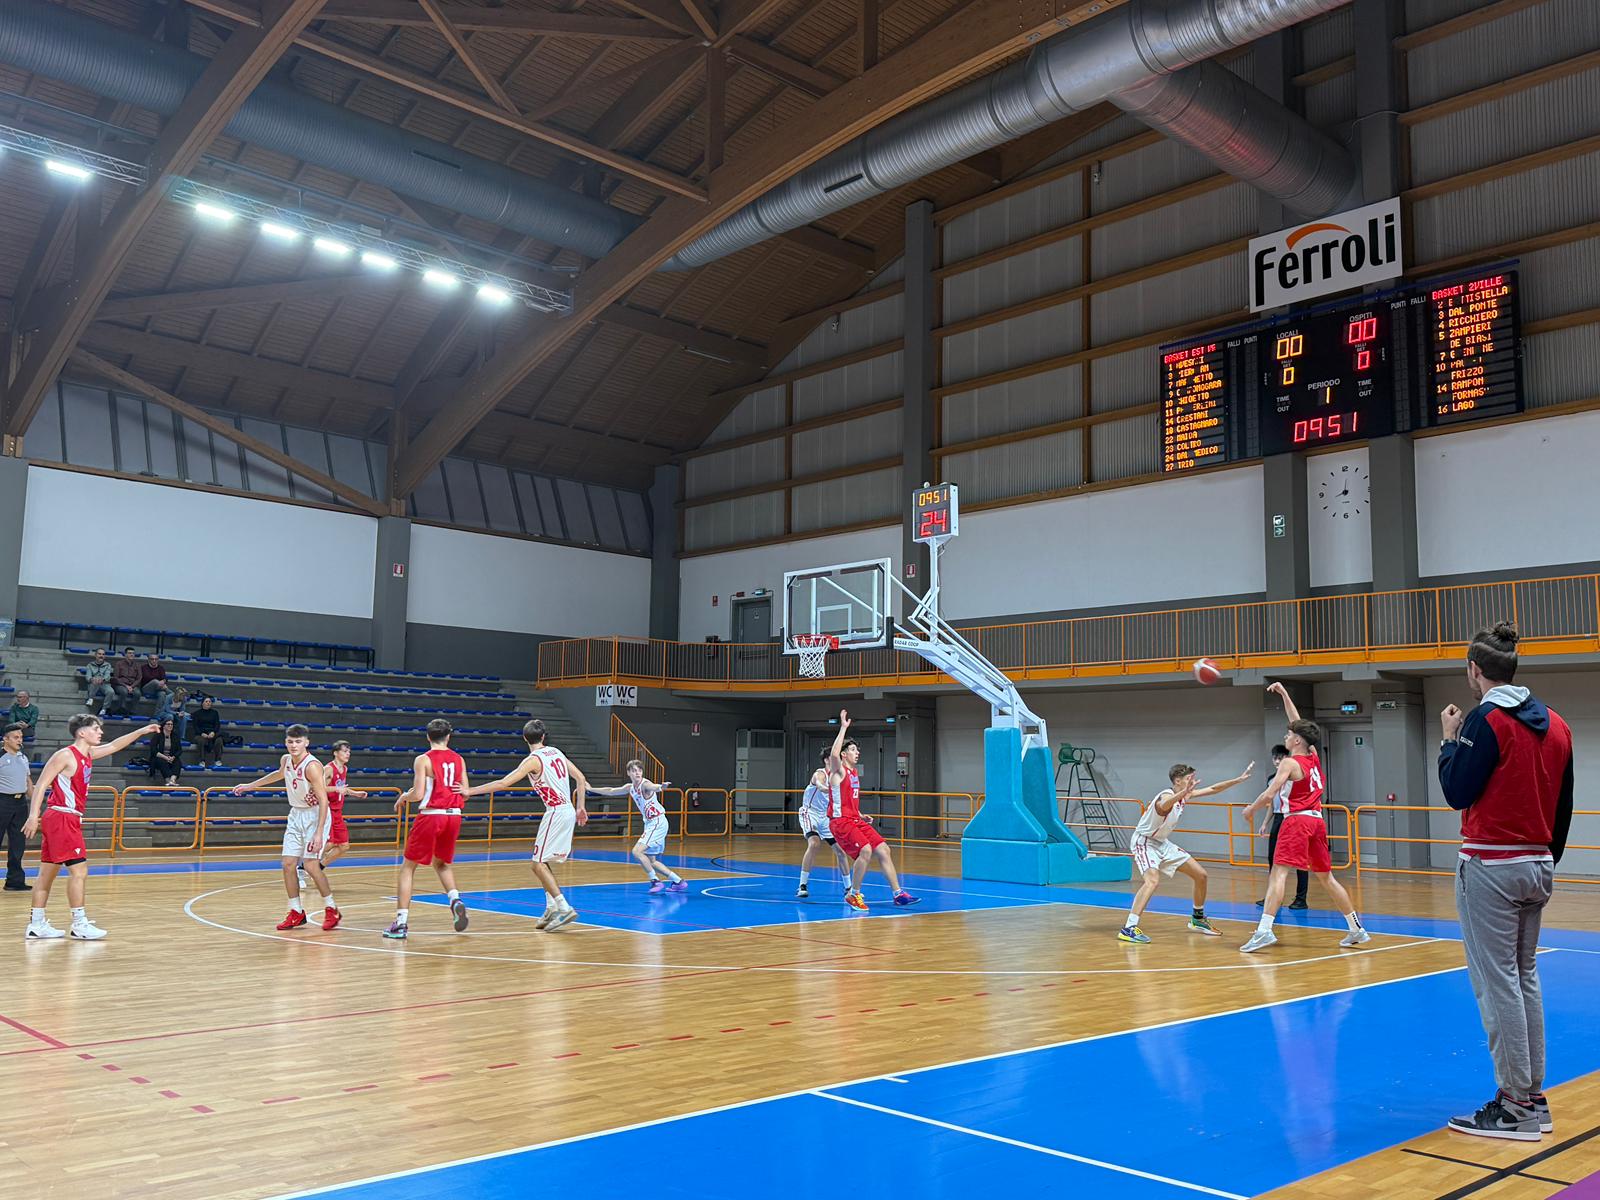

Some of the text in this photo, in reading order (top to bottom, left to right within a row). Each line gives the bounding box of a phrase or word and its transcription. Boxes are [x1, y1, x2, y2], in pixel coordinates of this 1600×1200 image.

[1255, 213, 1396, 307] Ferroli
[1432, 276, 1502, 300] BASKET 2VILLE
[1390, 300, 1406, 310] PUNTI
[1410, 296, 1426, 304] FALLI
[1449, 307, 1464, 317] DAL
[1470, 299, 1497, 313] PONTE
[1350, 312, 1372, 322] OSPITI
[1439, 310, 1498, 329] 4 RICCHIERO
[1276, 330, 1298, 340] LOCALI
[1439, 322, 1491, 340] 5 ZAMPIERI
[1450, 339, 1460, 349] DE
[1164, 351, 1188, 363] BASKET
[1192, 347, 1204, 356] EST
[1440, 352, 1446, 361] 7
[1436, 363, 1446, 372] 10
[1308, 378, 1341, 390] PERIODO
[1437, 384, 1447, 393] 14
[1326, 386, 1330, 404] 1
[1166, 400, 1174, 408] 10
[1438, 400, 1474, 414] 16 LAGO
[1165, 436, 1174, 444] 22
[1165, 445, 1174, 453] 23
[1177, 452, 1188, 460] DAL
[1178, 460, 1194, 469] TRIO
[921, 509, 947, 536] 24
[598, 686, 612, 698] WC
[617, 686, 635, 698] WC
[442, 762, 455, 786] 11
[550, 758, 566, 780] 10
[292, 779, 297, 789] 6
